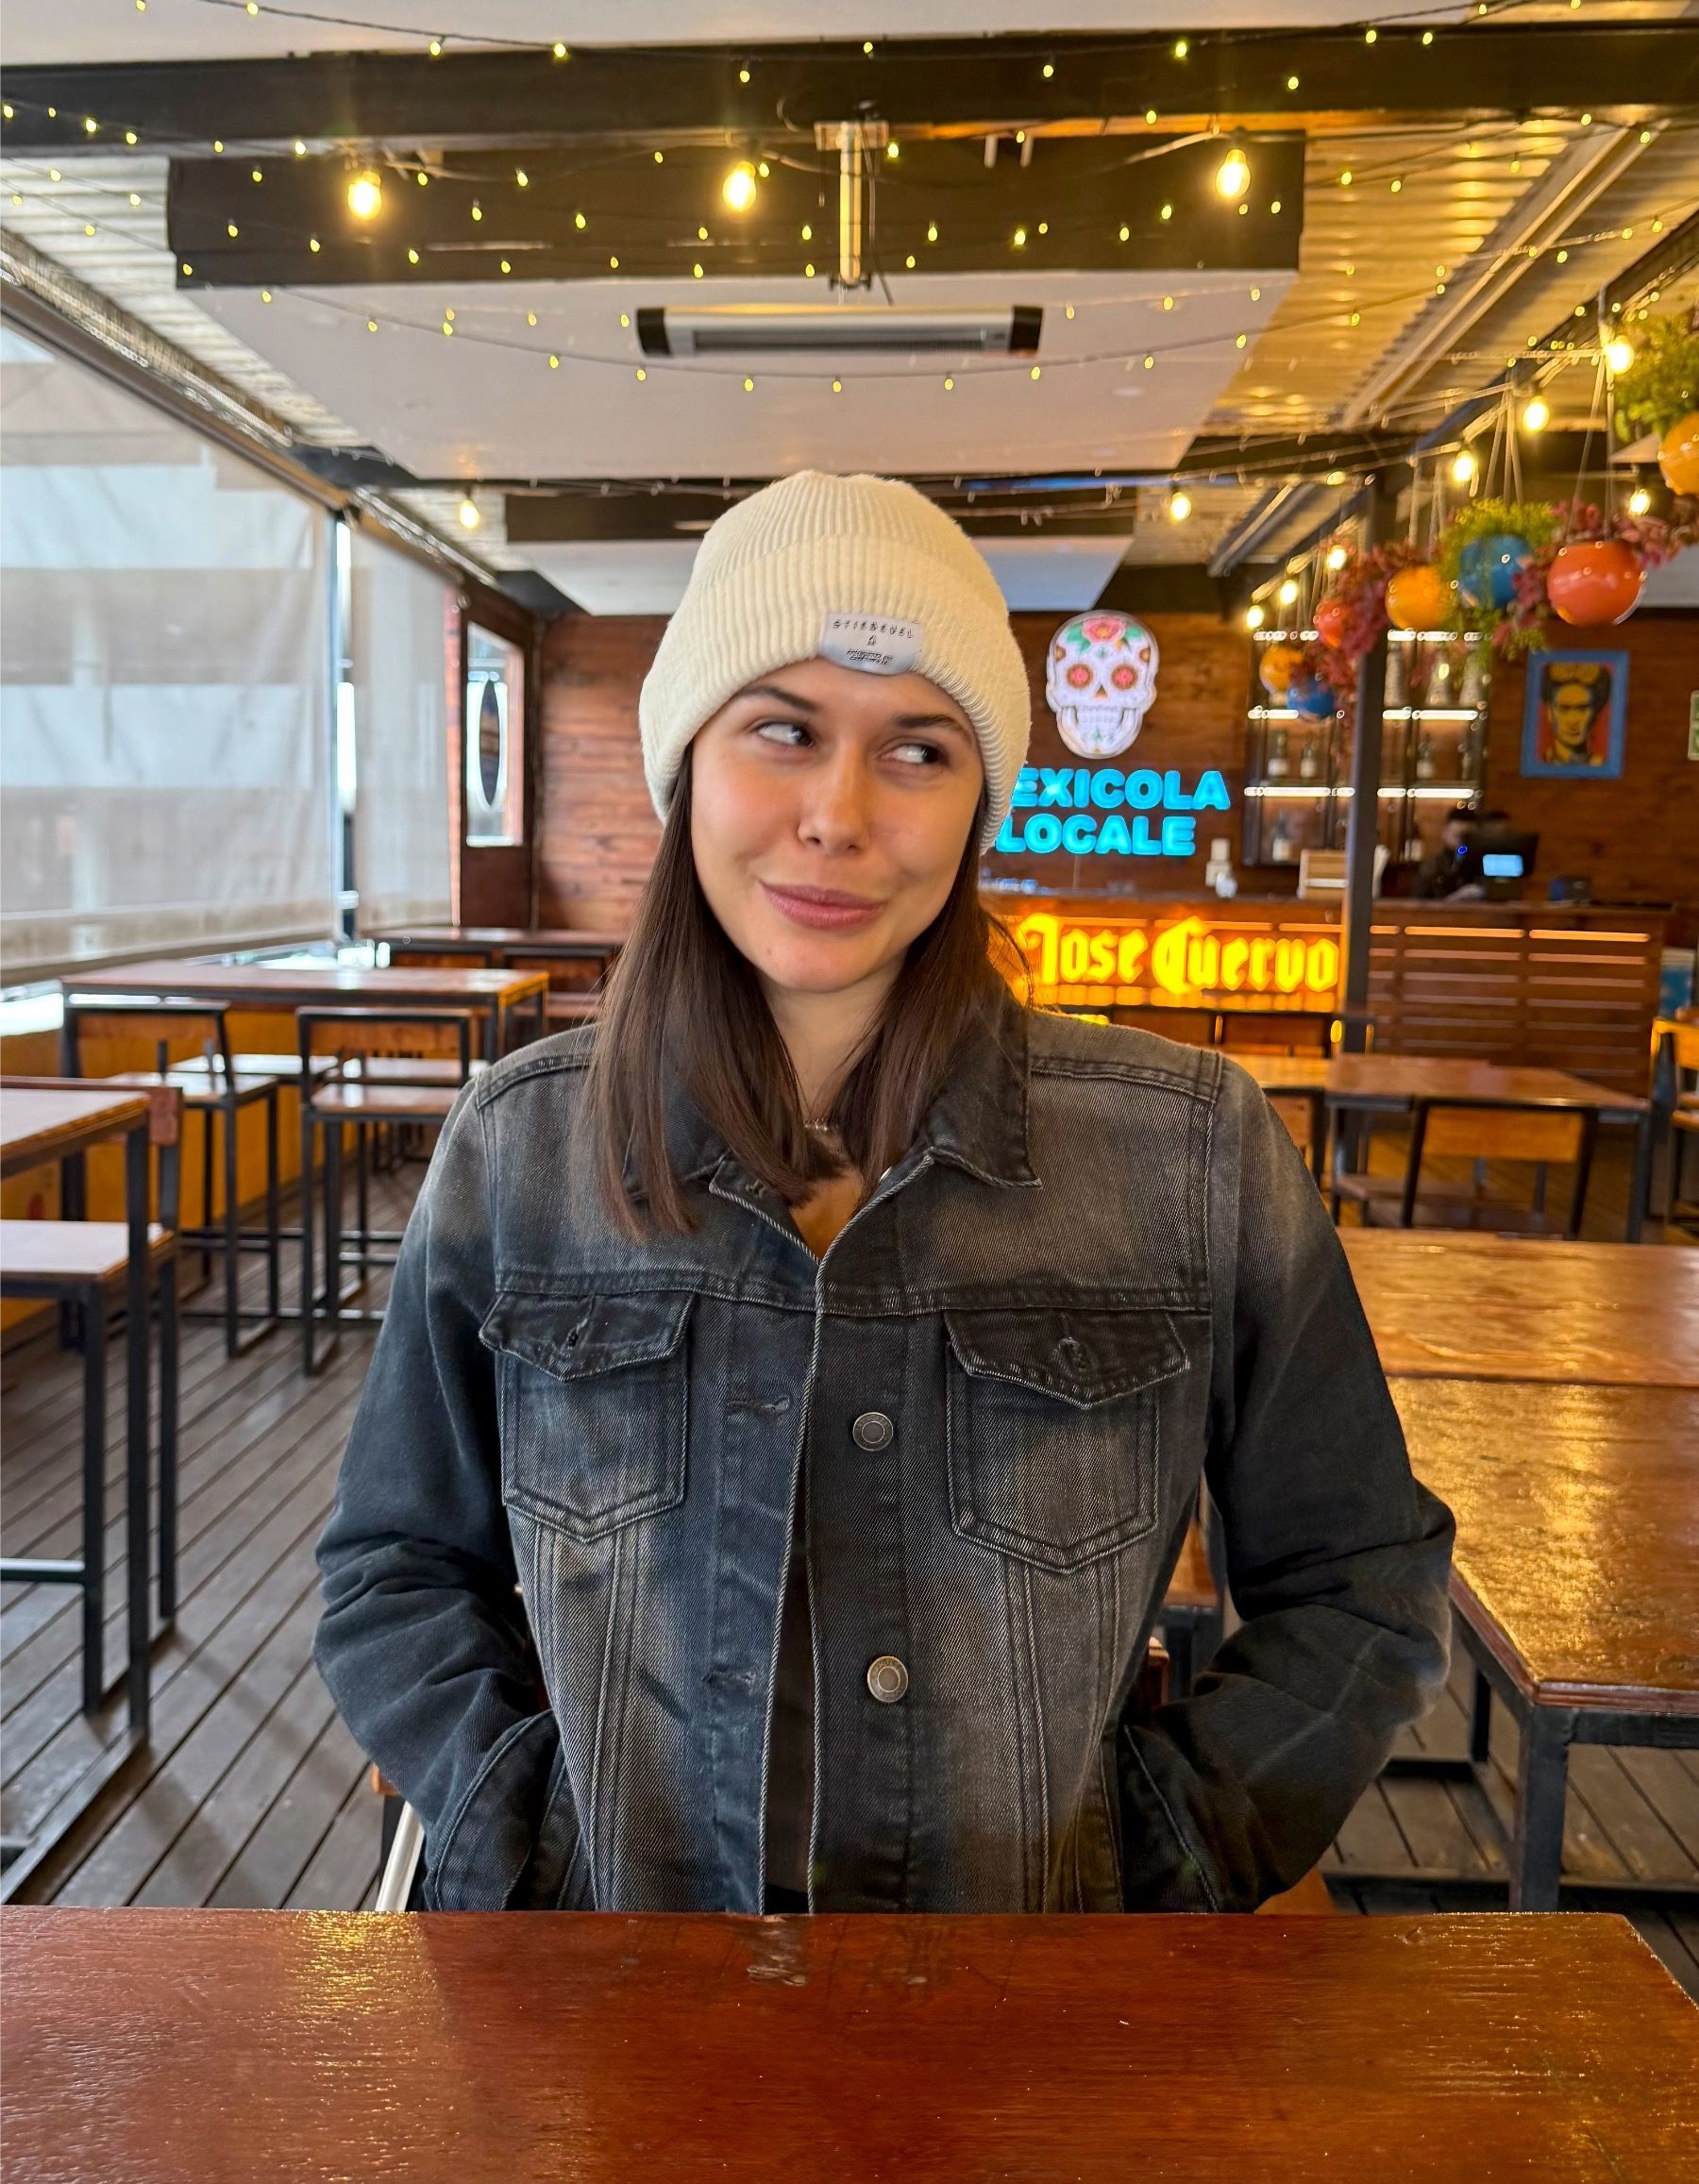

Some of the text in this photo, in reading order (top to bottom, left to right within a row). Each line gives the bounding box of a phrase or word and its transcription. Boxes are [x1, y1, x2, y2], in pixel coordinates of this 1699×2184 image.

[1010, 767, 1231, 810] EXICOLA
[995, 814, 1197, 856] LOCALE
[1017, 913, 1339, 994] Jose Cuervo
